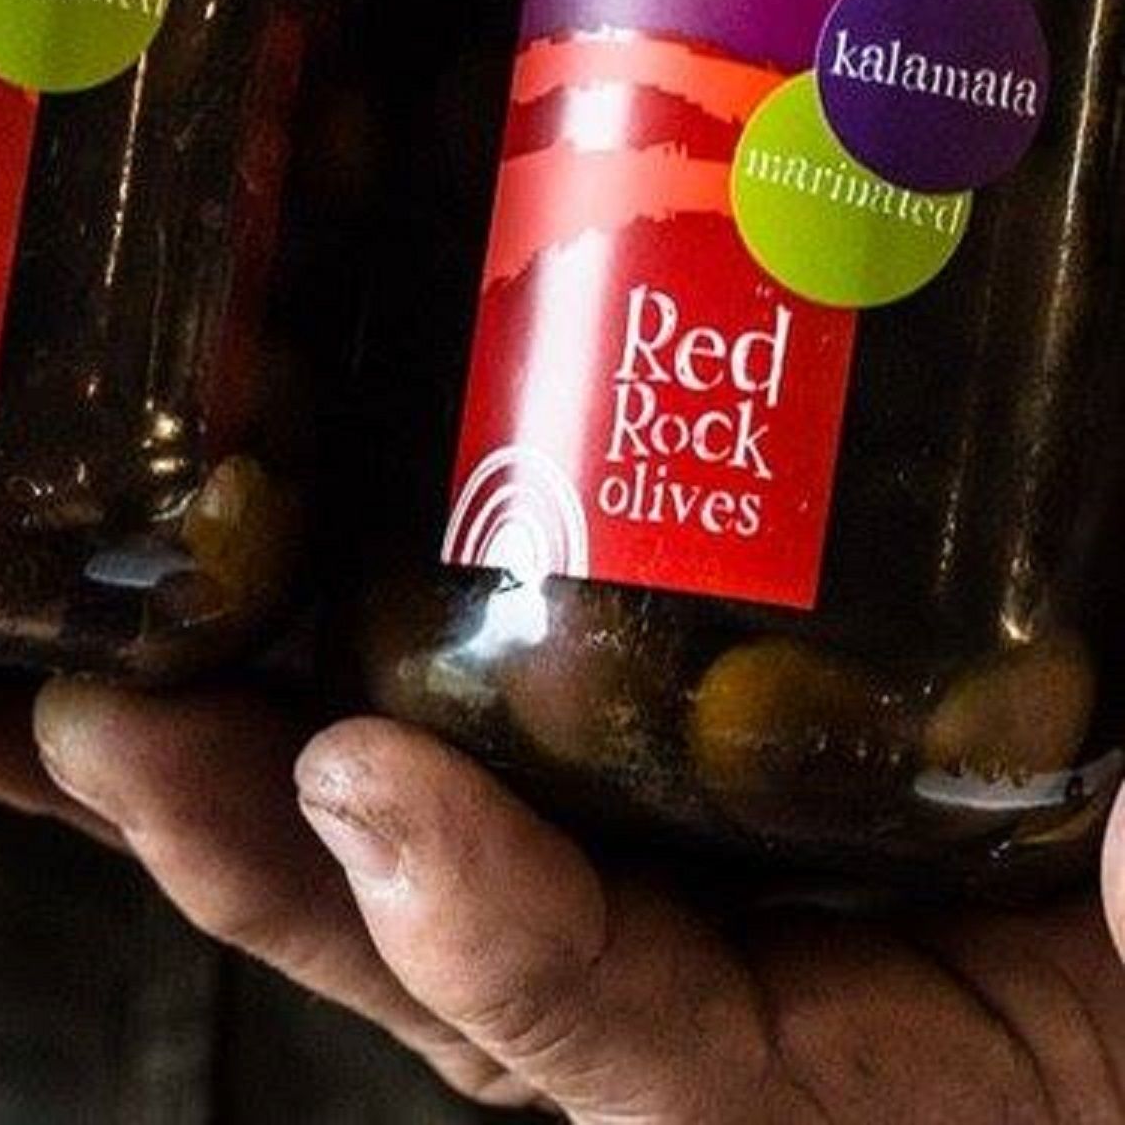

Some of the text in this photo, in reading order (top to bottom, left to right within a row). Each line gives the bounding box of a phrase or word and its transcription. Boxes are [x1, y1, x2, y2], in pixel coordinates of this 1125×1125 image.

[831, 28, 1038, 117] kalamata
[744, 146, 964, 236] marinated
[614, 283, 792, 408] Red
[605, 377, 773, 480] Rock
[597, 461, 762, 537] olives
